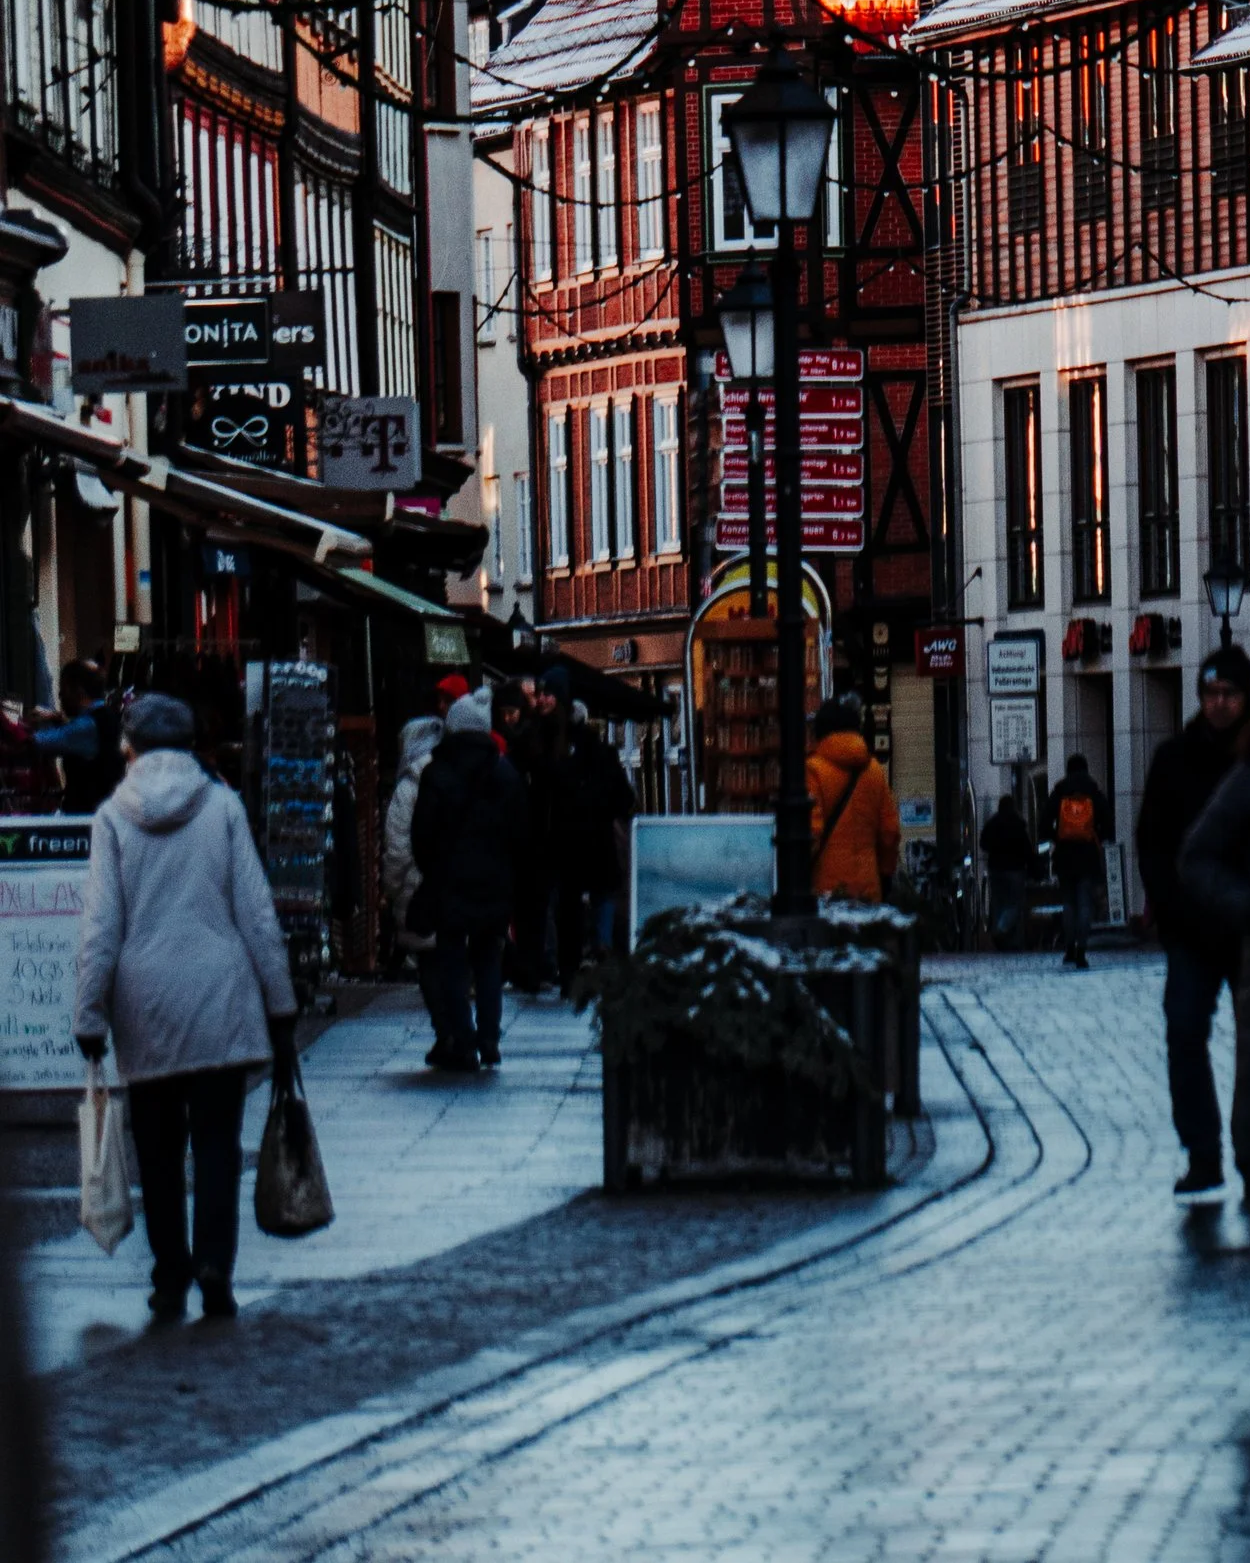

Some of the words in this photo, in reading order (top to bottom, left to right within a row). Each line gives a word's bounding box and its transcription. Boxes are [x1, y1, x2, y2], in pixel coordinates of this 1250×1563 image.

[184, 318, 259, 348] ONITA
[272, 324, 316, 343] ers
[29, 834, 89, 852] freen
